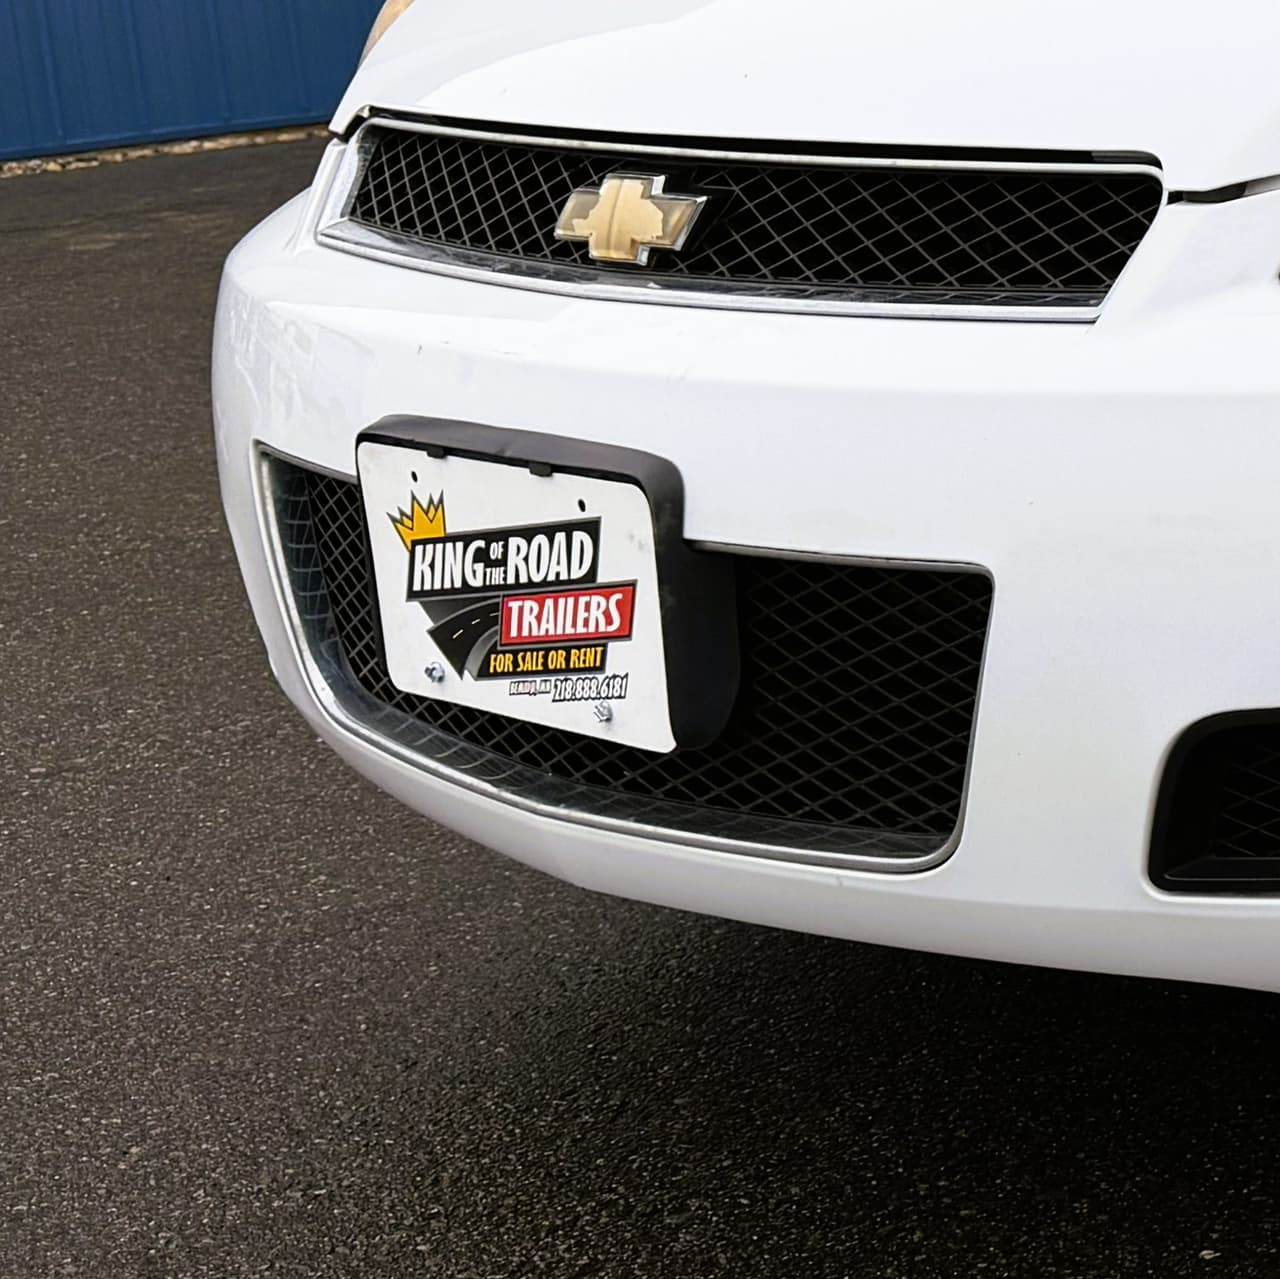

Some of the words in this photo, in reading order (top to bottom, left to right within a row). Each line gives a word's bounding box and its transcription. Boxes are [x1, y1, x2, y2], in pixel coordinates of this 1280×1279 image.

[411, 539, 486, 592] KING
[489, 541, 505, 560] OF
[506, 530, 594, 584] ROAD
[484, 566, 506, 586] THE
[507, 592, 624, 638] TRAILERS
[489, 653, 513, 673] FOR
[516, 651, 545, 672] SALE
[547, 650, 566, 670] OR
[570, 647, 604, 669] RENT
[552, 672, 629, 703] 218.888.6181
